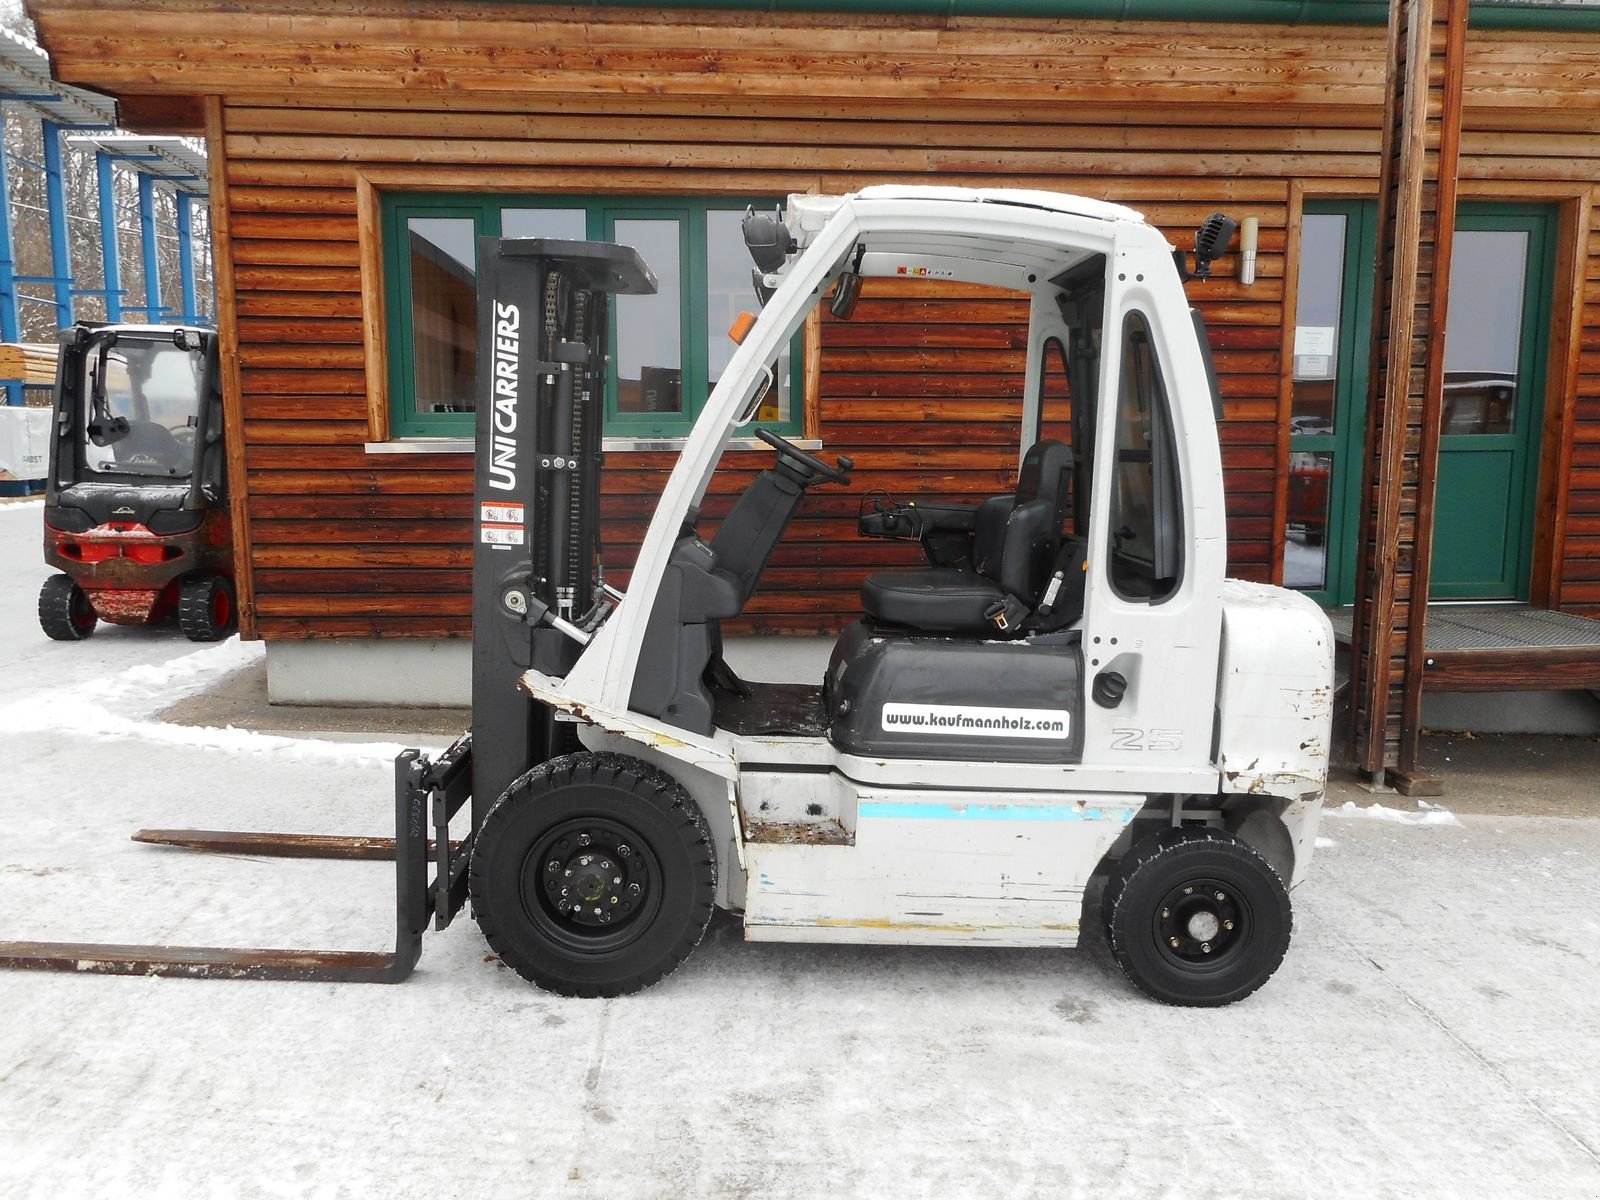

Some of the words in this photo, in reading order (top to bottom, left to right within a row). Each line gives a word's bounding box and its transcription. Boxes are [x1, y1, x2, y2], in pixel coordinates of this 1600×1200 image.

[489, 299, 520, 491] UNICARRIERS
[886, 713, 1064, 732] www.kaufmannholz.com
[1111, 728, 1184, 751] 25
